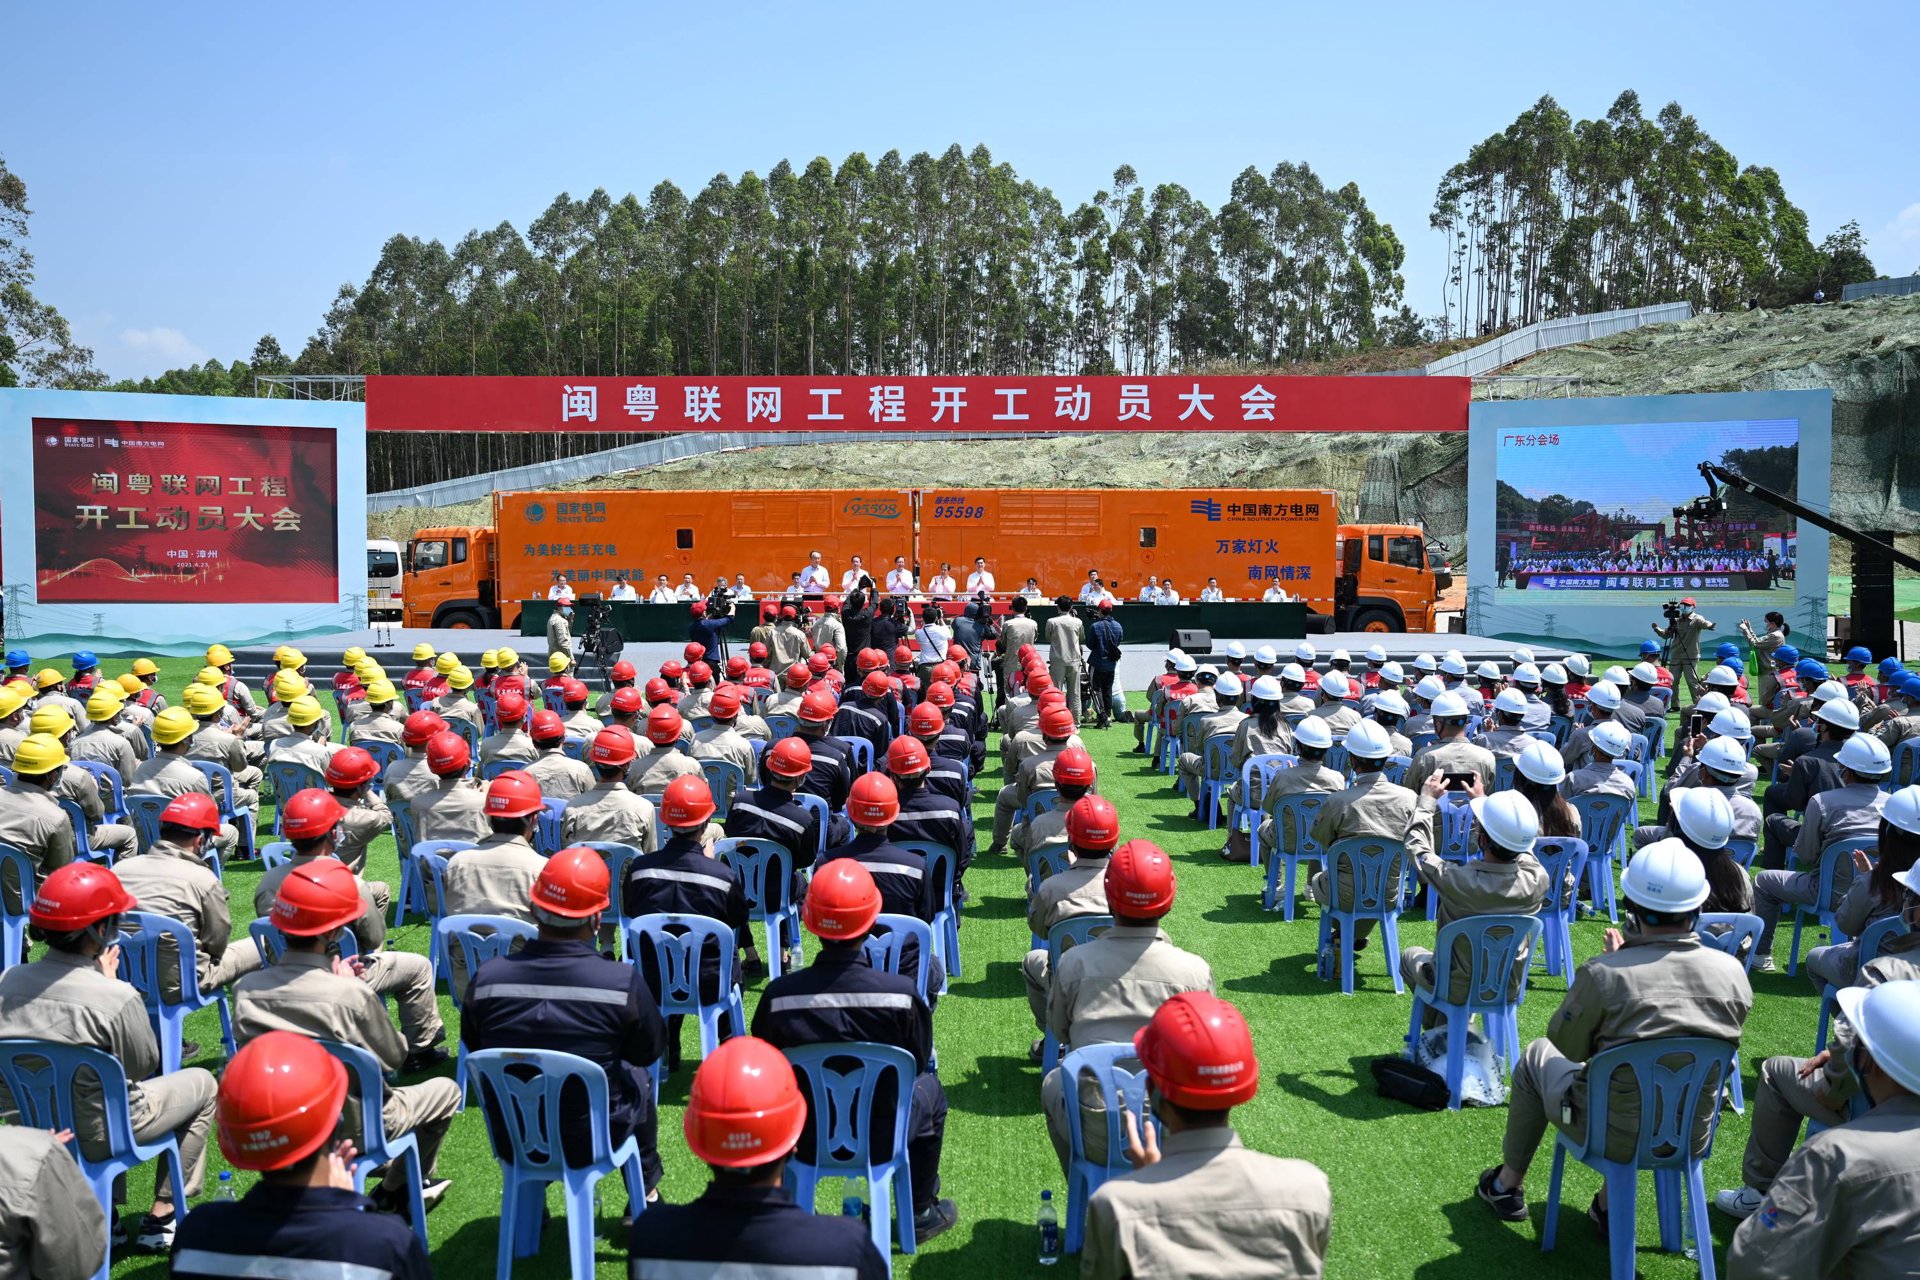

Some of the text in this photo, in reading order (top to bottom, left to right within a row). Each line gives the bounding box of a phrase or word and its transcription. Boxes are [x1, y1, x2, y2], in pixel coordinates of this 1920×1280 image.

[561, 383, 1277, 423] 闽粤联网工程开工动员大会
[1503, 434, 1560, 447] 广东分会场
[91, 472, 287, 497] 闽粤联网工程
[556, 502, 606, 514] 国家电网
[934, 506, 984, 518] 95598
[1227, 503, 1319, 516] 中国南方电网
[75, 504, 302, 532] 开工动员大会
[524, 544, 617, 556] 为美好生活充电
[1216, 539, 1279, 554] 万家灯火
[1248, 565, 1311, 580] 南网情深
[1606, 576, 1685, 588] 闽粤联网工程
